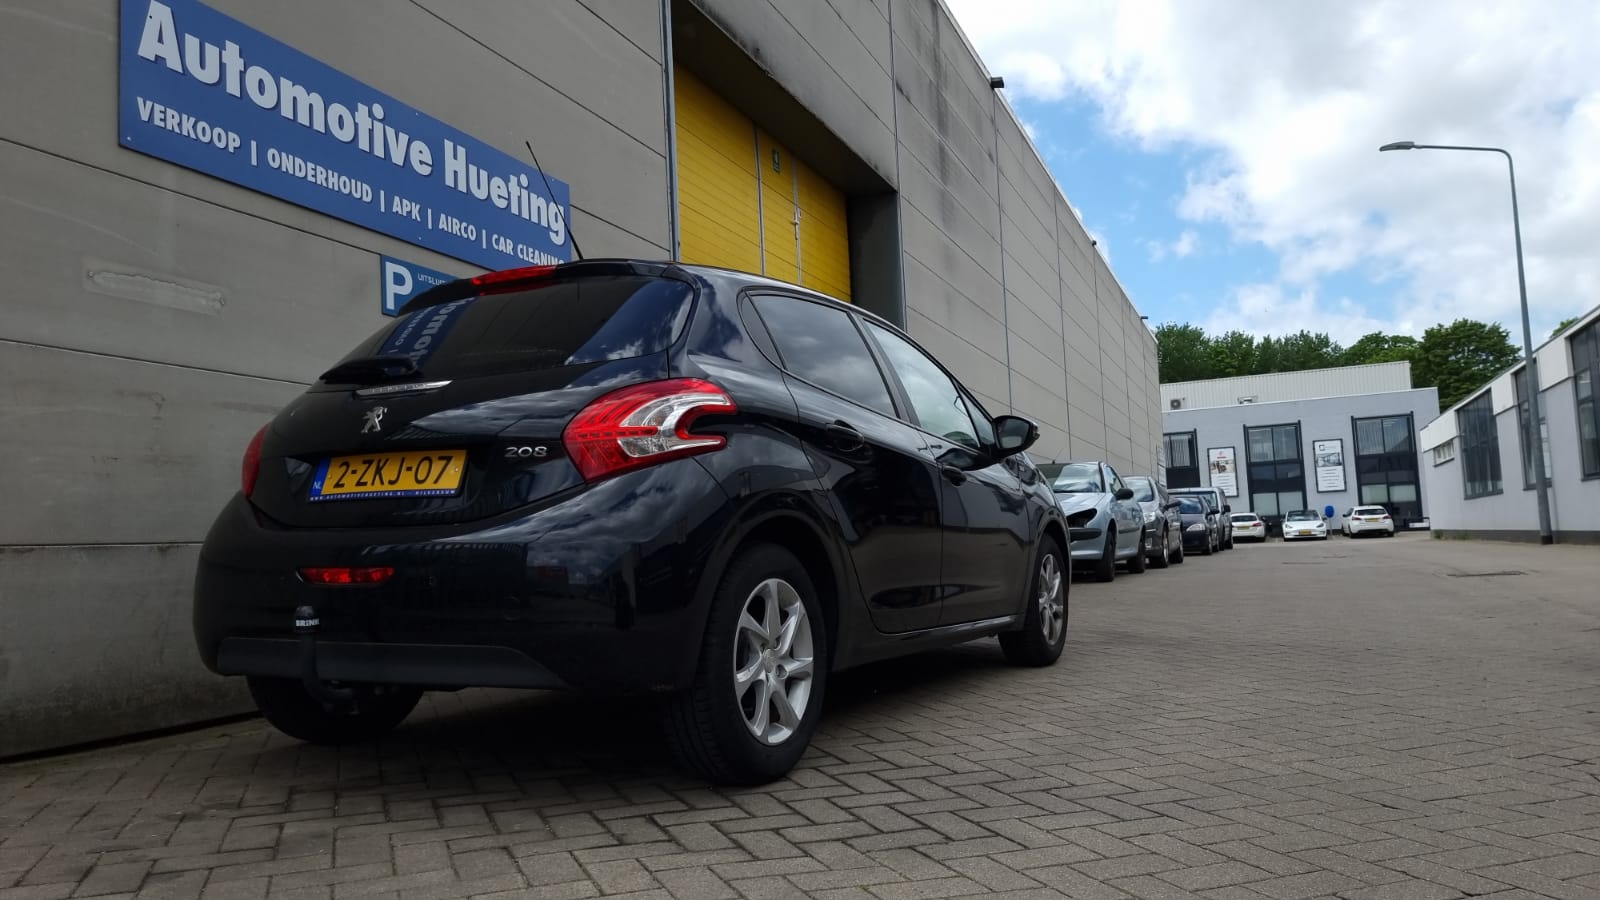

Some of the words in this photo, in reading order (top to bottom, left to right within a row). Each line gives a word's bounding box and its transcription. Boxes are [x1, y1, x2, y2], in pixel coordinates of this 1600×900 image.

[137, 0, 433, 176] Automotive
[444, 138, 566, 246] Hueting
[137, 96, 241, 153] VERKOOP
[267, 148, 373, 203] ONDERHOUD
[392, 196, 421, 221] APK
[438, 213, 477, 241] AIRCO
[492, 233, 514, 256] CAR
[385, 261, 413, 310] P
[333, 455, 453, 489] 2-ZKJ-07
[504, 446, 548, 458] 208
